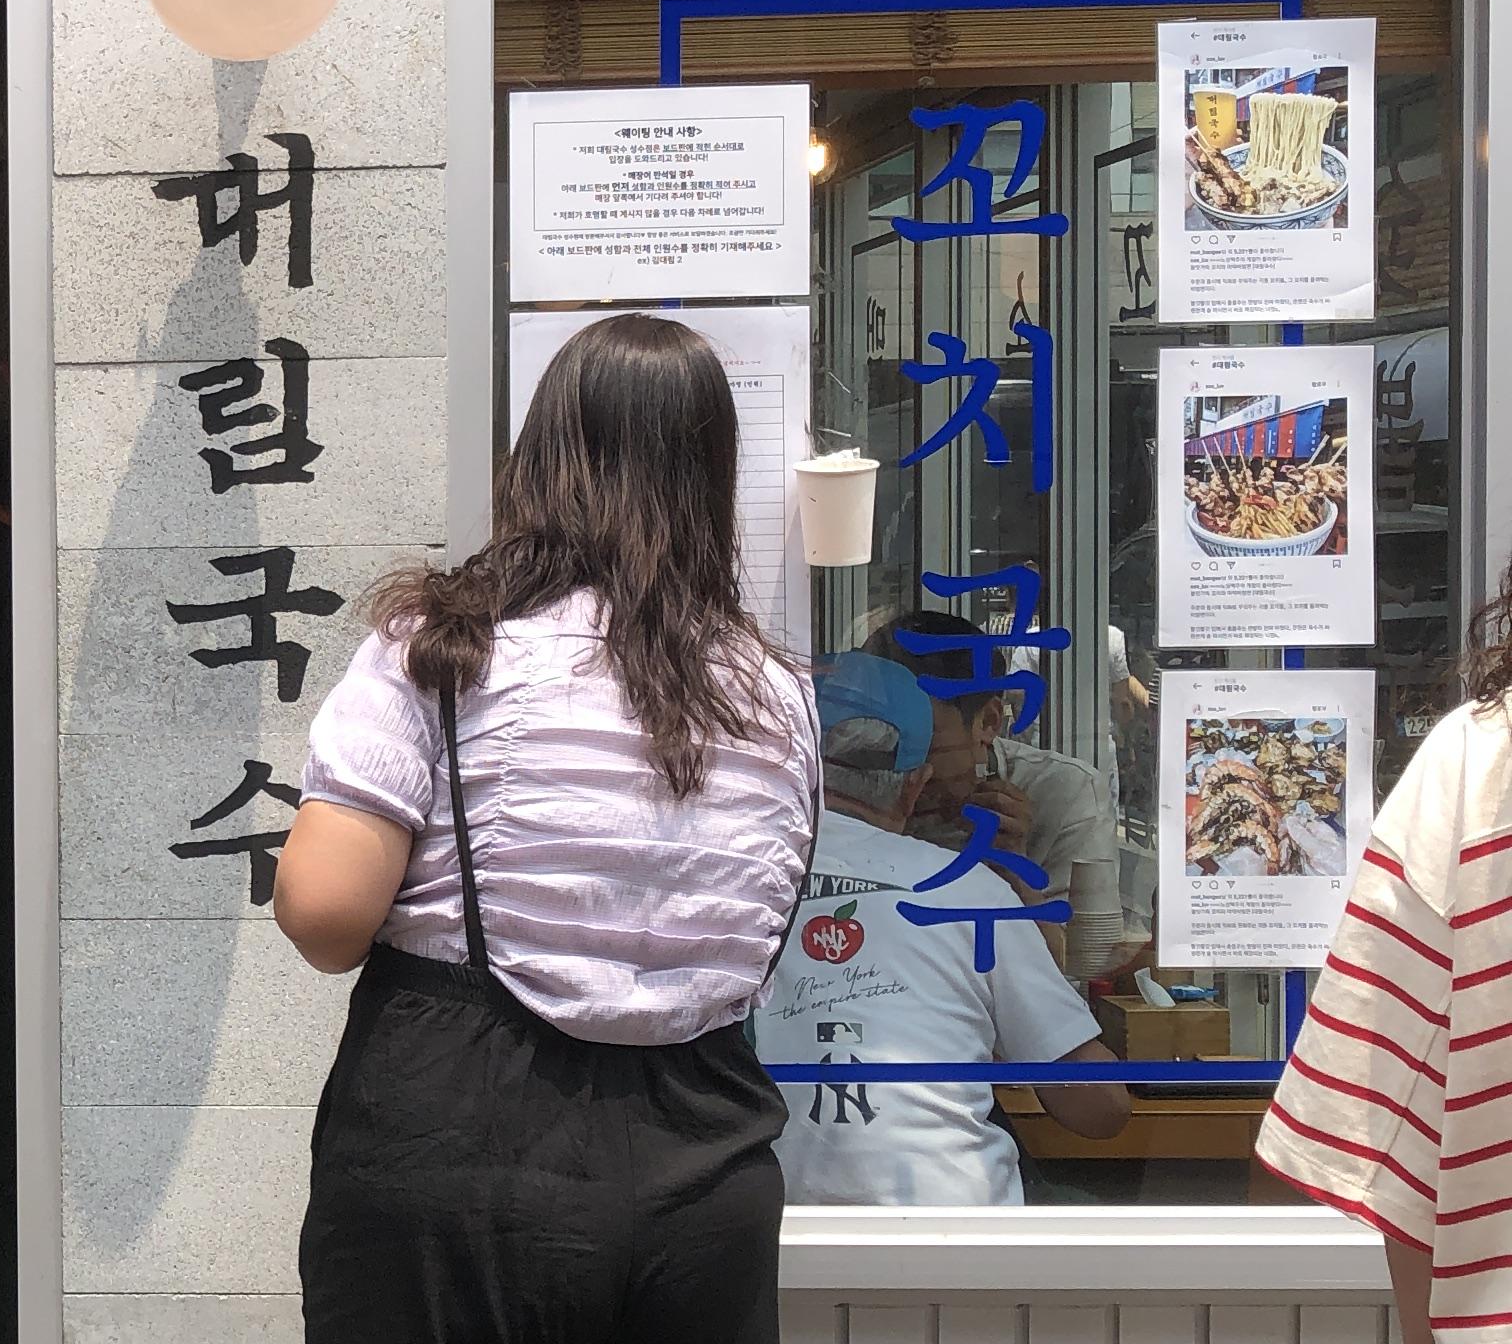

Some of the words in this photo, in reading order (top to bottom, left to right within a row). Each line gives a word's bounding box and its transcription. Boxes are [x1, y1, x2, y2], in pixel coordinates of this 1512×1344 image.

[653, 126, 674, 138] 안내
[151, 131, 346, 907] 대림국수
[891, 99, 1074, 974] 꼬치국수
[830, 876, 879, 896] YORK
[842, 963, 881, 994] York
